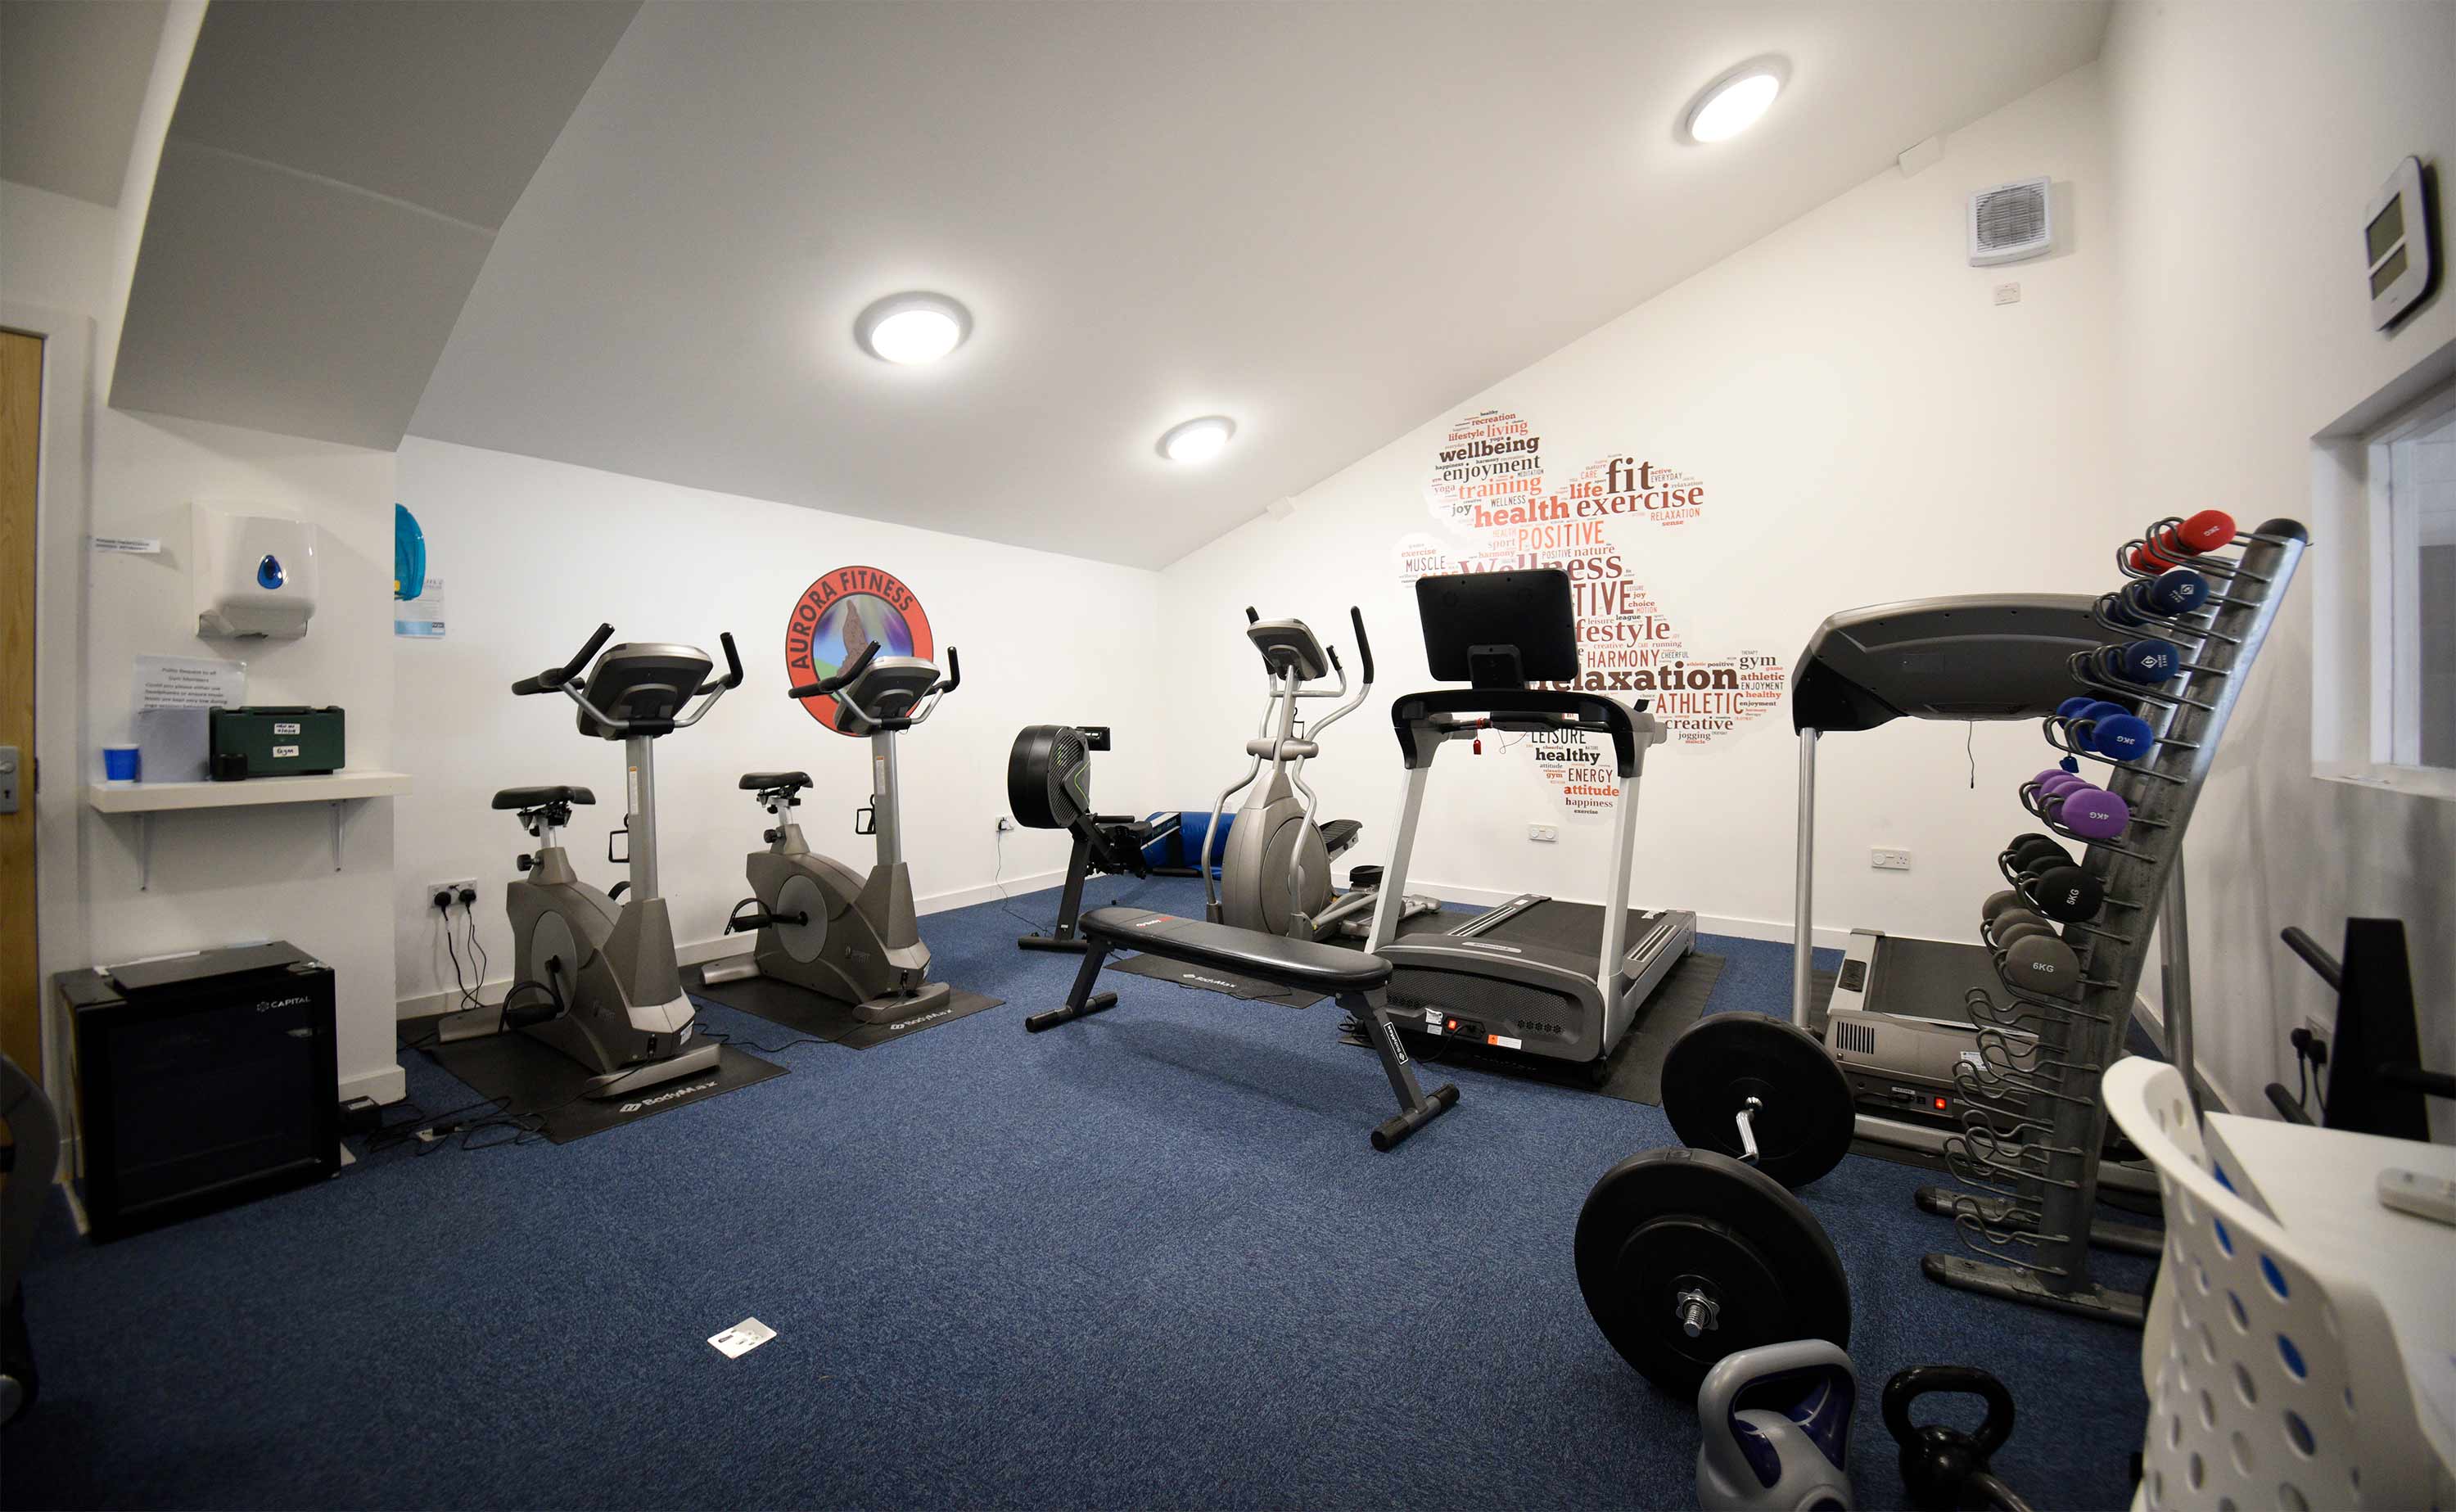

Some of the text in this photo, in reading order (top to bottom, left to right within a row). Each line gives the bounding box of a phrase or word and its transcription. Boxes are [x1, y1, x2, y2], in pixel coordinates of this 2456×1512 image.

[1472, 413, 1516, 426] recreation
[1448, 428, 1485, 442] lifestyle
[1487, 421, 1528, 437] living
[1439, 436, 1540, 463] wellbeing
[1435, 462, 1464, 471] happiness
[1443, 455, 1541, 483] enjoyment
[1580, 470, 1597, 481] CARE
[1605, 457, 1655, 495] fit
[1650, 472, 1682, 483] EVERYDAY
[1434, 484, 1456, 494] yoga
[1459, 475, 1542, 499] training
[1569, 481, 1603, 499] life
[1491, 494, 1526, 508] WELLNESS
[1577, 482, 1704, 517] exercise
[1451, 503, 1473, 517] joy
[1474, 494, 1570, 528] health
[1650, 508, 1700, 521] RELAXATION
[1519, 521, 1605, 551] POSITIVE
[1488, 538, 1515, 550] sport
[1401, 548, 1437, 557] exercise
[1479, 549, 1515, 559] harmony
[1542, 549, 1571, 559] POSITIVE
[1574, 546, 1615, 557] nature
[1406, 556, 1446, 572] MUSCLE
[1573, 580, 1634, 616] TIVE
[790, 571, 914, 670] AURORA FITNESS
[1575, 616, 1670, 648] festyle
[1587, 649, 1660, 669] HARMONY
[1661, 651, 1690, 660] CHEERFUL
[1740, 656, 1777, 670] gym
[1740, 672, 1785, 681] athletic
[1740, 682, 1784, 691] ENJOYMENT
[1745, 691, 1782, 700] healthy
[1655, 693, 1744, 715] ATHLETIC
[1665, 716, 1734, 730] creative
[1532, 728, 1587, 745] LEISURE
[1678, 731, 1711, 741] jogging
[2116, 736, 2135, 745] 3KG
[1535, 747, 1600, 765] healthy
[1568, 768, 1614, 783] ENERGY
[1564, 784, 1620, 797] attitude
[1565, 797, 1614, 809] happiness
[2089, 810, 2110, 820] 4KG
[2066, 888, 2080, 906] 5KG
[2032, 962, 2055, 973] 6KG
[271, 995, 311, 1008] CAPITAL
[642, 1081, 718, 1106] BodyMax
